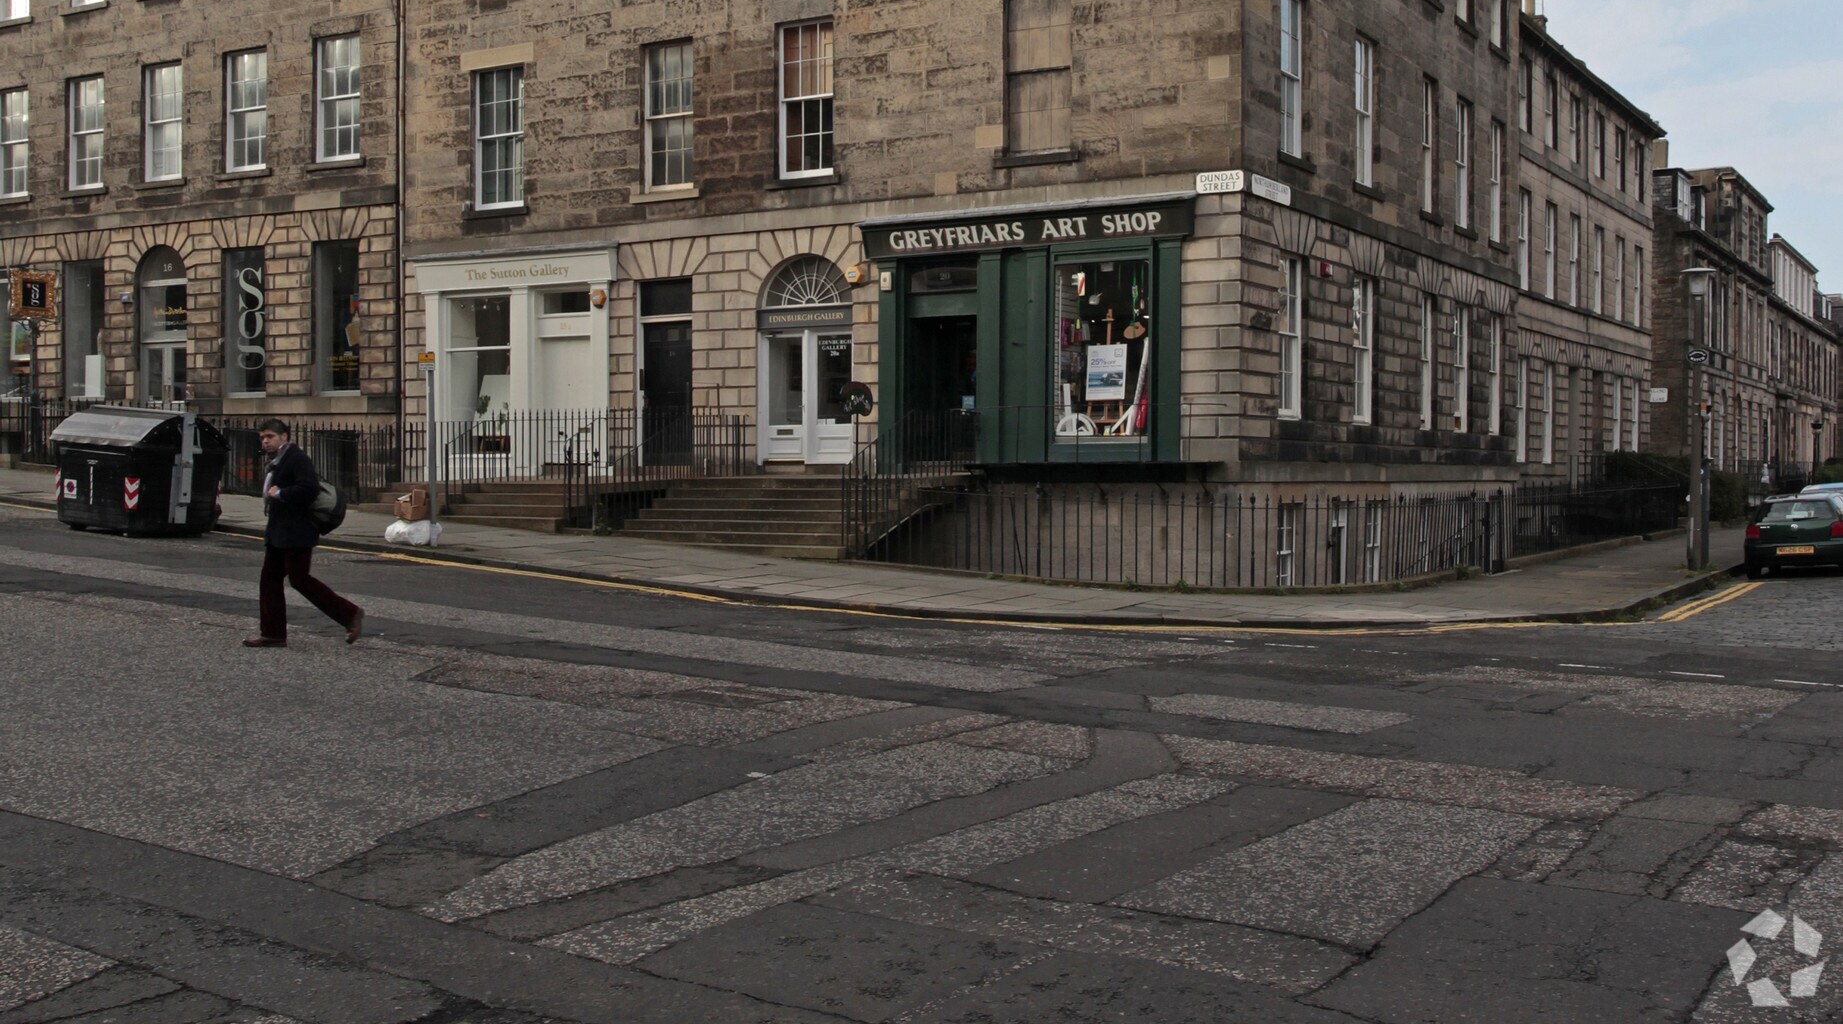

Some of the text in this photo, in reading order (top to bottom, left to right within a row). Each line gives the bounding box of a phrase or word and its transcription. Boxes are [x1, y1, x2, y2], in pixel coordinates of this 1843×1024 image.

[1200, 172, 1240, 183] DUNDAS
[1203, 182, 1237, 191] STREET
[889, 211, 1162, 250] GREYFRIARS ART SHOP
[163, 263, 173, 272] 16
[465, 264, 569, 281] The Sutton Gallery
[769, 312, 844, 323] EDINBURGH GALLERY
